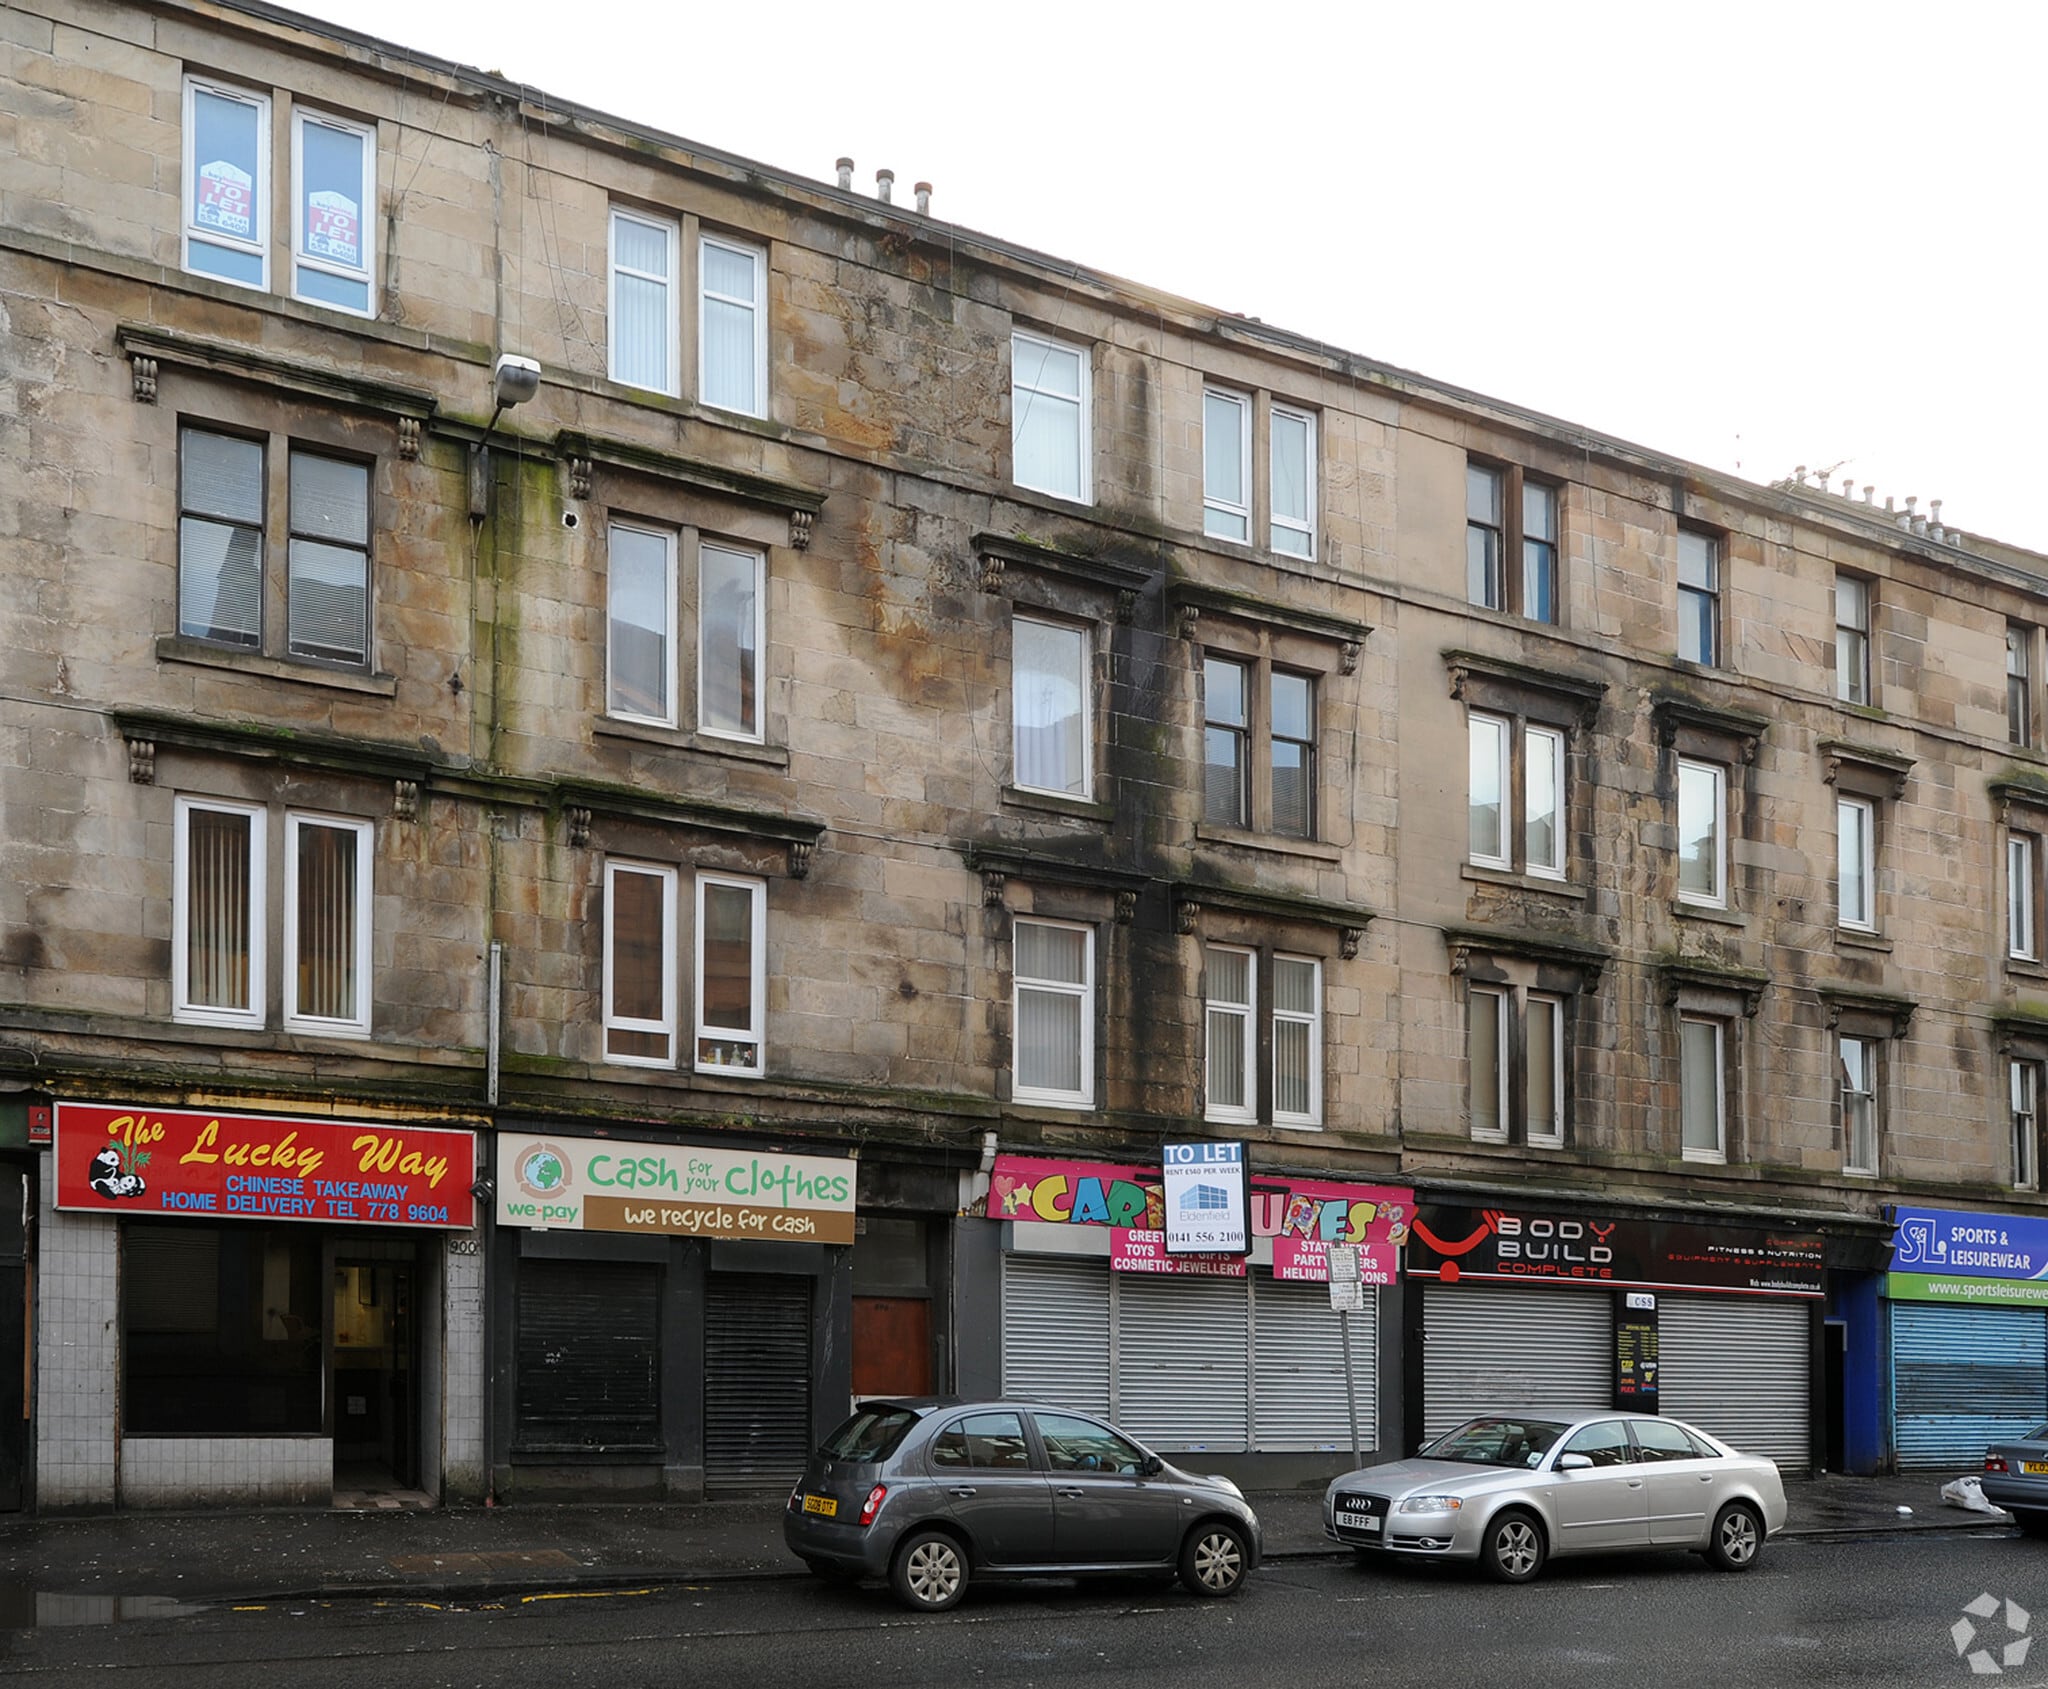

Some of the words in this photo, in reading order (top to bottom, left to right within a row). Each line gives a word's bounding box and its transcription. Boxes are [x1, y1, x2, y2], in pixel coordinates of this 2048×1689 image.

[212, 182, 242, 199] TO
[206, 192, 248, 213] LET
[320, 211, 350, 228] TO
[315, 222, 354, 241] LET
[107, 1115, 166, 1147] The
[179, 1119, 325, 1178] Lucky
[352, 1134, 449, 1189] Way
[1164, 1145, 1195, 1163] TO
[1203, 1143, 1241, 1162] LET
[688, 1158, 713, 1176] for
[226, 1175, 304, 1195] CHINESE
[313, 1180, 409, 1200] TAKEAWAY
[683, 1175, 720, 1195] your
[162, 1191, 217, 1210] HOME
[226, 1194, 316, 1215] DELIVERY
[326, 1200, 359, 1218] TEL
[367, 1202, 399, 1220] 778
[408, 1204, 448, 1222] 9604
[507, 1202, 579, 1223] we-pay
[661, 1207, 732, 1233] recycle
[737, 1209, 768, 1232] for
[1250, 1193, 1378, 1243] UNES
[1168, 1232, 1191, 1242] 0141
[1195, 1231, 1215, 1242] 556
[1219, 1231, 1244, 1242] 2100
[1498, 1217, 1616, 1243] BODY
[1951, 1226, 1997, 1245] SPORTS
[2001, 1231, 2009, 1246] &
[451, 1241, 477, 1254] 900
[1125, 1243, 1156, 1257] TOYS
[1899, 1217, 1947, 1264] SL
[1294, 1254, 1327, 1266] PARTY
[1498, 1240, 1613, 1263] BUILD
[1707, 1246, 1755, 1255] FITNESS
[1767, 1250, 1822, 1260] NUTRITION
[1951, 1249, 2031, 1270] LEISUREWEAR
[1113, 1257, 1174, 1272] COSMETIC
[1176, 1261, 1241, 1276] JEWELLERY
[1283, 1267, 1327, 1280] HELIUM
[1497, 1262, 1613, 1278] COMPLETE
[1744, 1258, 1822, 1270] SUPPLEMENTS
[1343, 1514, 1353, 1525] E8
[1353, 1515, 1370, 1527] FFF
